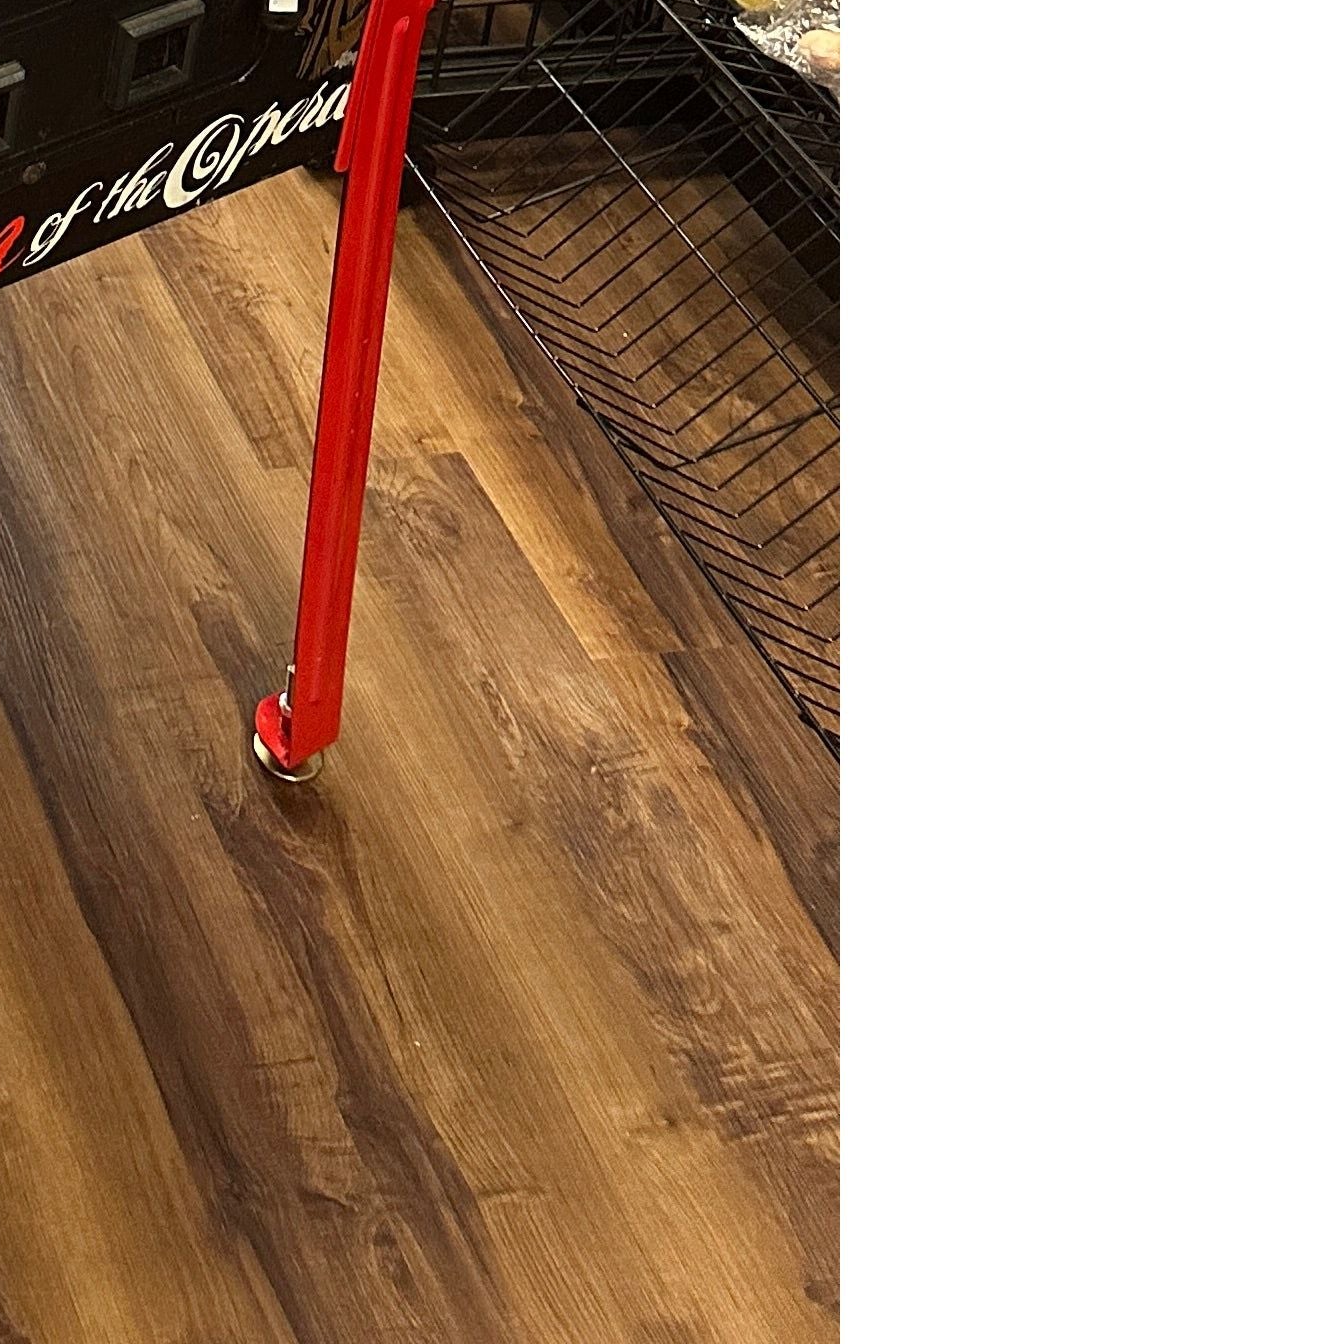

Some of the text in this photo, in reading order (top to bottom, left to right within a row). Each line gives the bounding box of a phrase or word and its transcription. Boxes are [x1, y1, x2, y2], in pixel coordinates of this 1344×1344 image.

[23, 181, 98, 268] of
[101, 140, 168, 228] the
[163, 78, 351, 216] Opera
